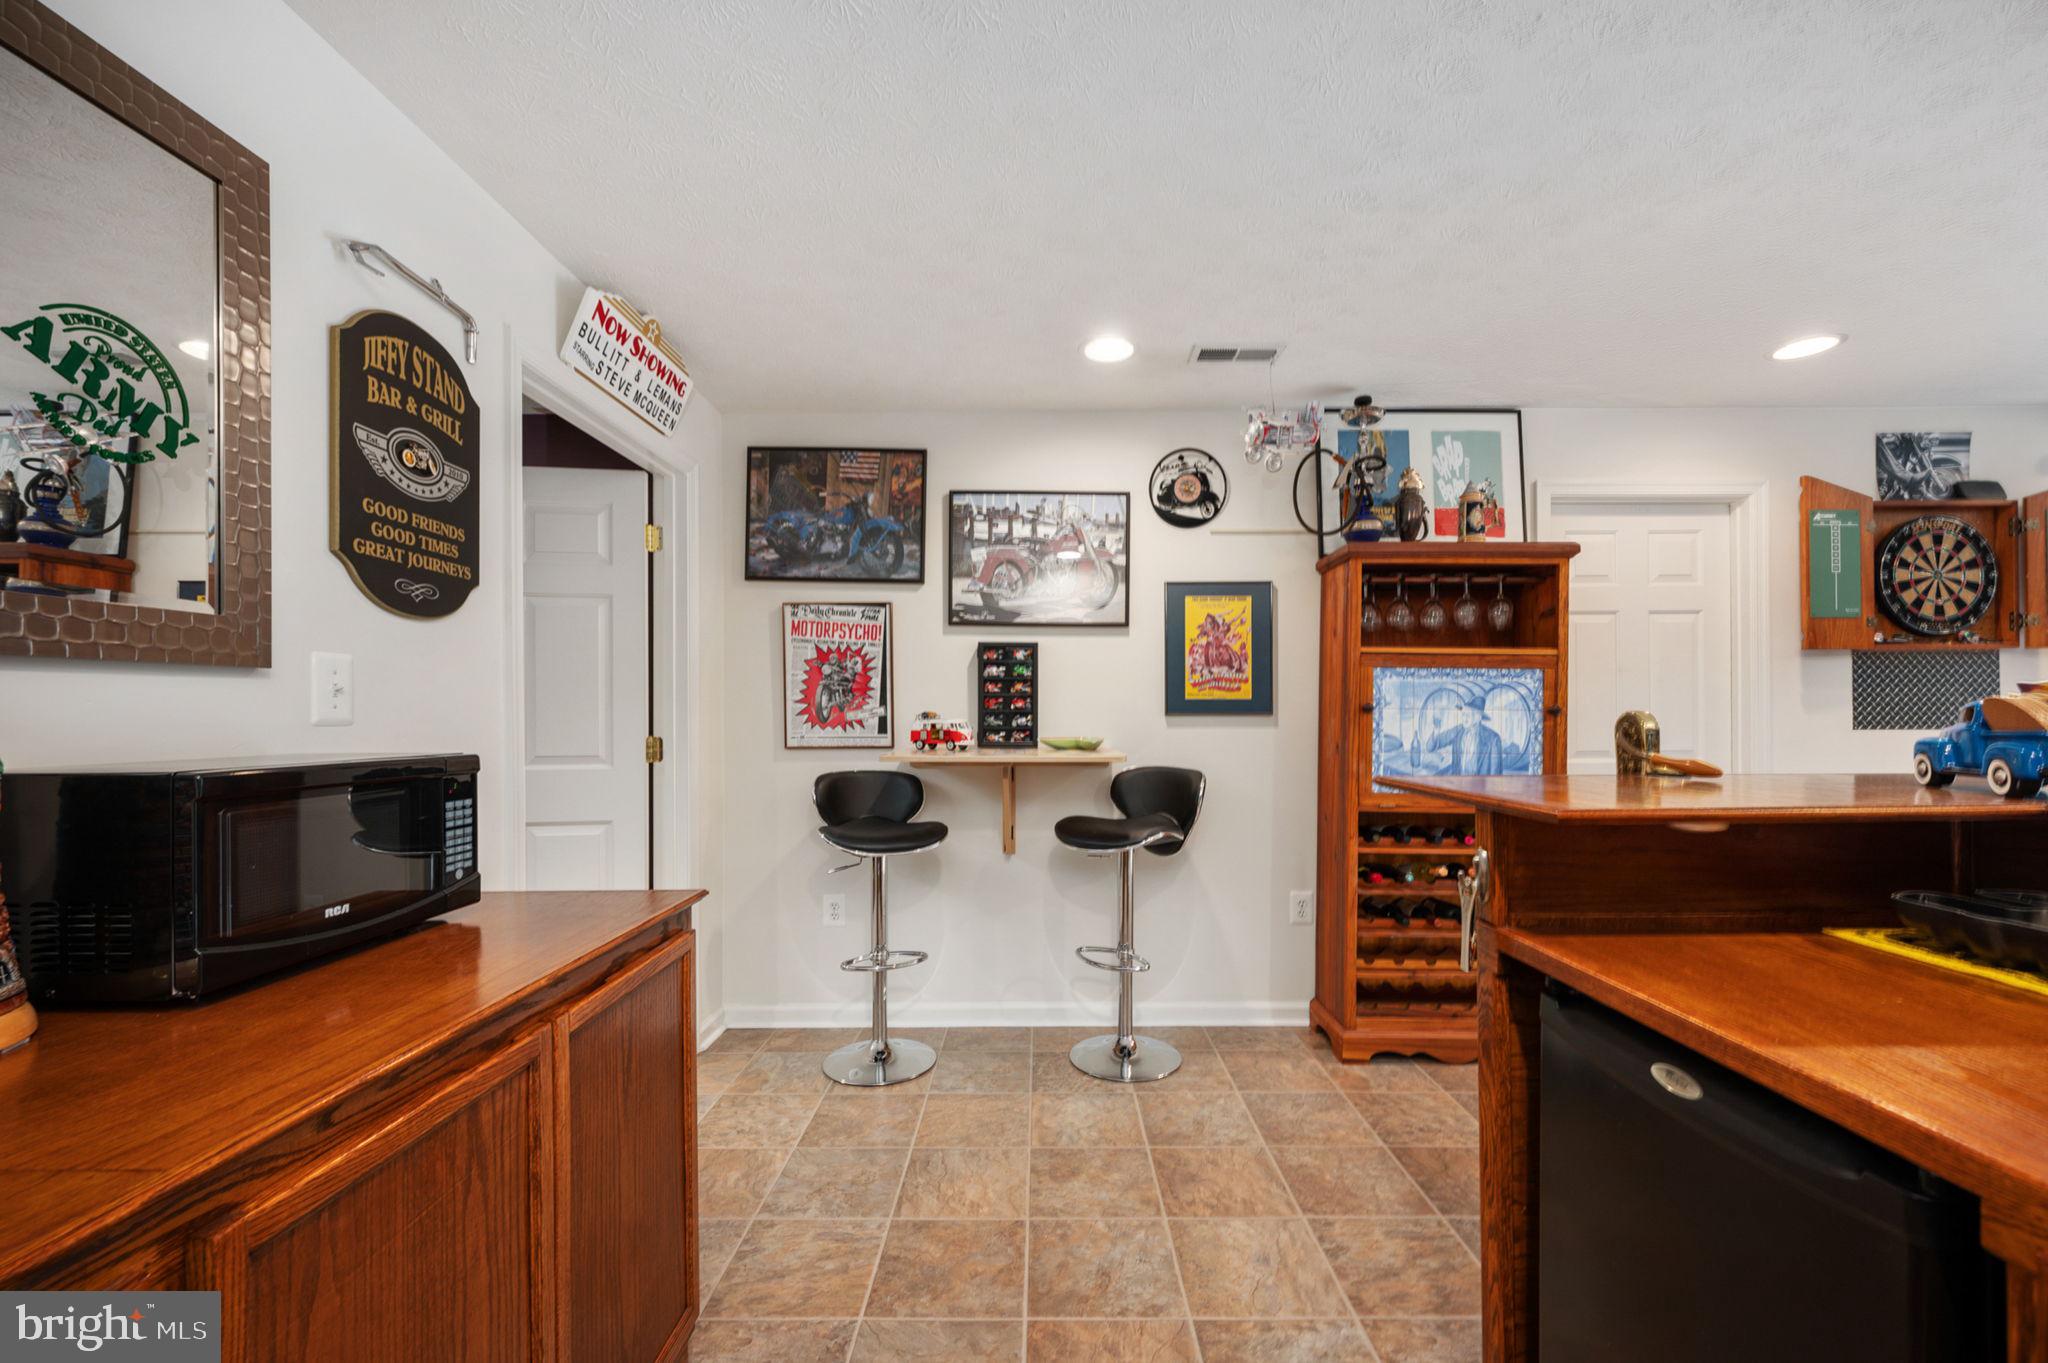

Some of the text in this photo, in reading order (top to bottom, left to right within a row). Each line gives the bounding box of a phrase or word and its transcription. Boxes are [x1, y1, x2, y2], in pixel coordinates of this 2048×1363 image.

[84, 335, 150, 382] Proud
[578, 321, 683, 416] BULLITT & LEMANS
[592, 299, 687, 398] NOW SHOWING
[0, 316, 200, 459] ARMY
[363, 335, 465, 415] JIFFY STAND
[595, 360, 632, 397] STEVE
[633, 390, 677, 431] MCQUEEN
[57, 393, 127, 438] Dad
[367, 374, 463, 446] BAR & GRILL
[366, 433, 380, 447] Est.
[362, 497, 466, 542] GOOD FRIENDS
[370, 521, 460, 559] GOOD TIMES
[352, 537, 472, 580] GREAT JOURNEYS
[790, 619, 883, 642] MOTORPSYCHO!
[325, 903, 350, 918] RCA
